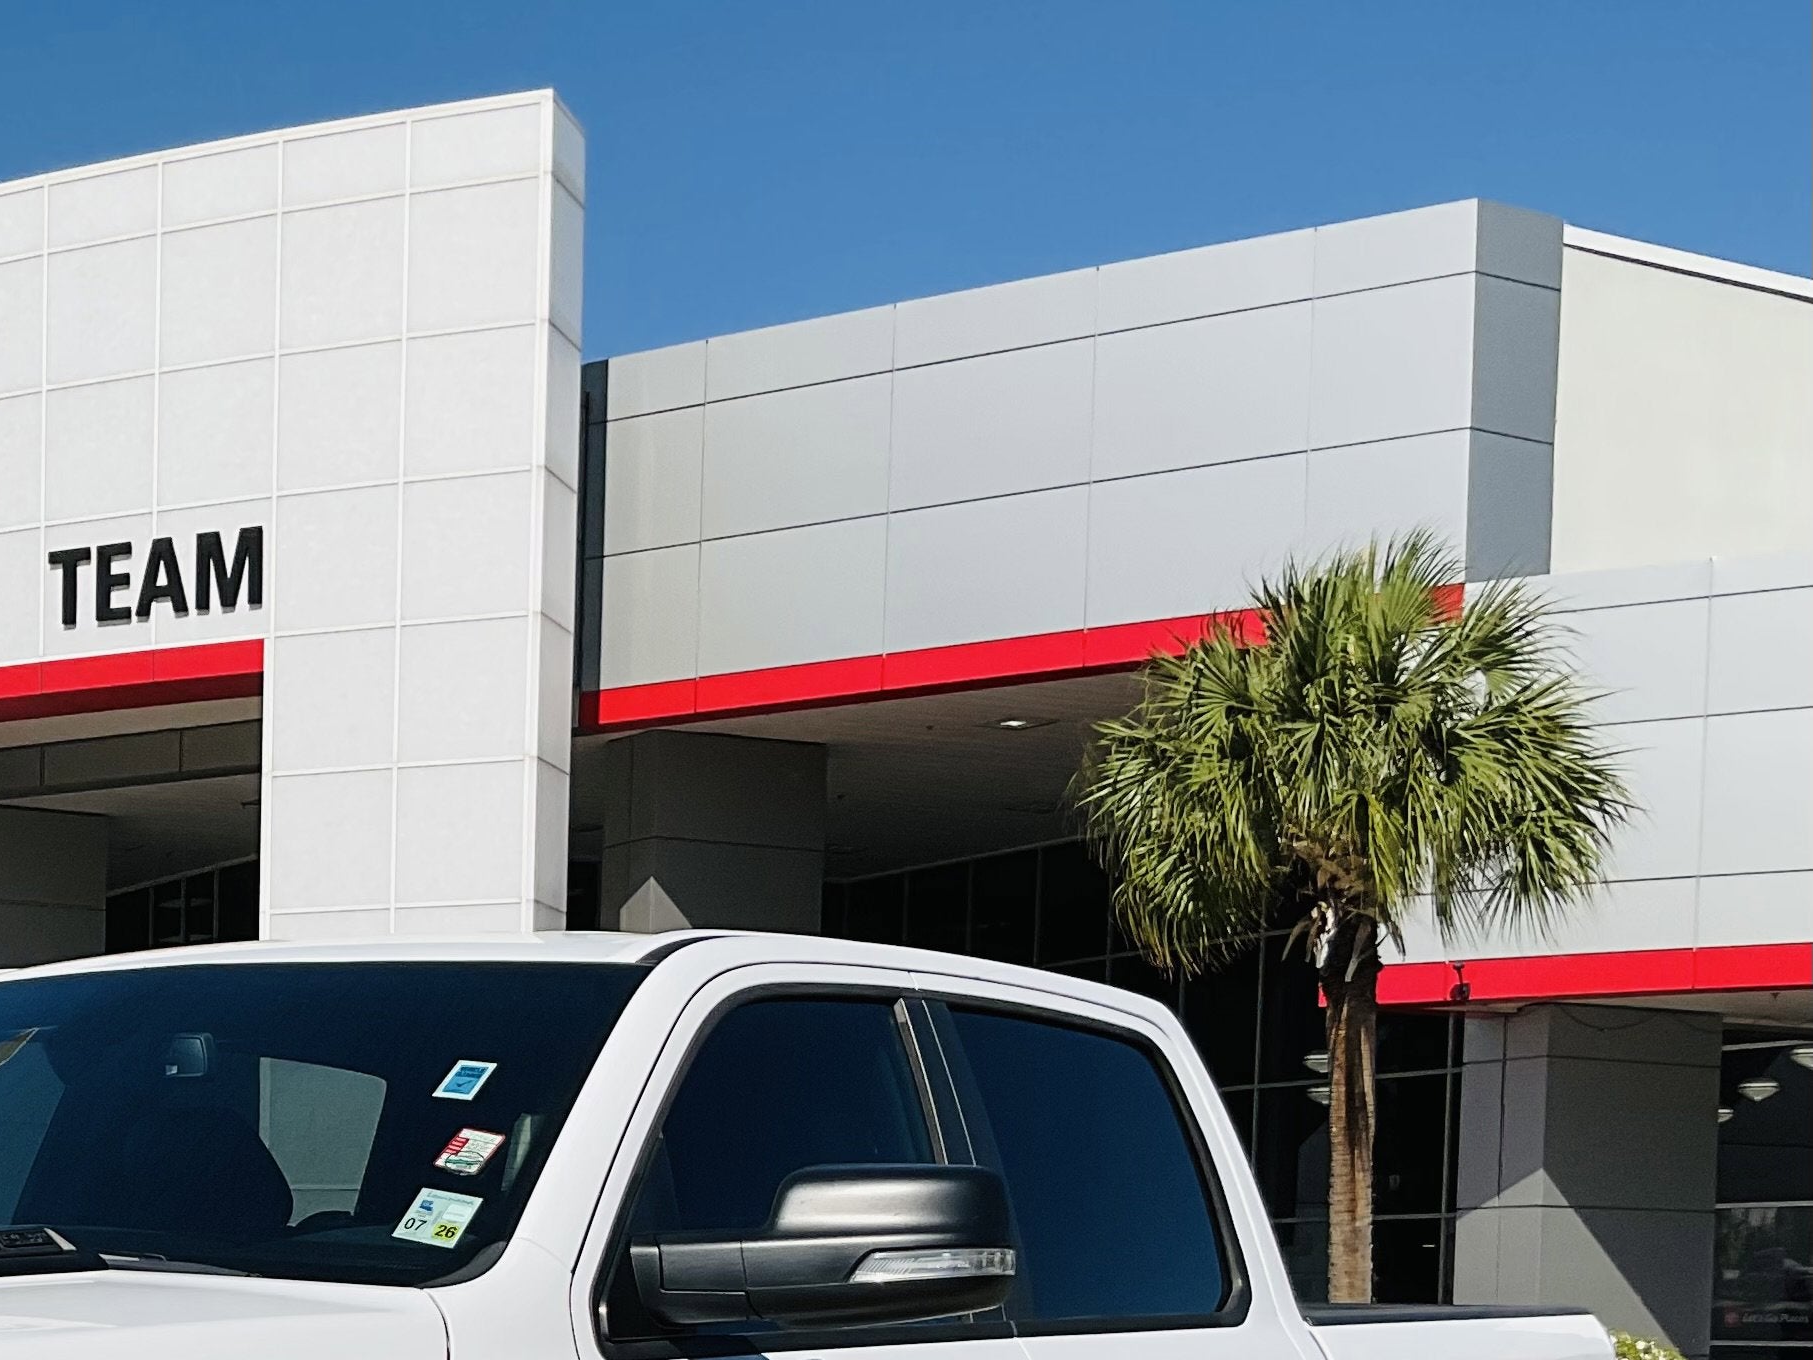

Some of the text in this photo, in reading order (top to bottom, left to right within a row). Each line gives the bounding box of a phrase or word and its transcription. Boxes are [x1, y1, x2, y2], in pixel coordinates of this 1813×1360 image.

[48, 526, 263, 626] TEAM
[404, 1217, 458, 1239] 07 26
